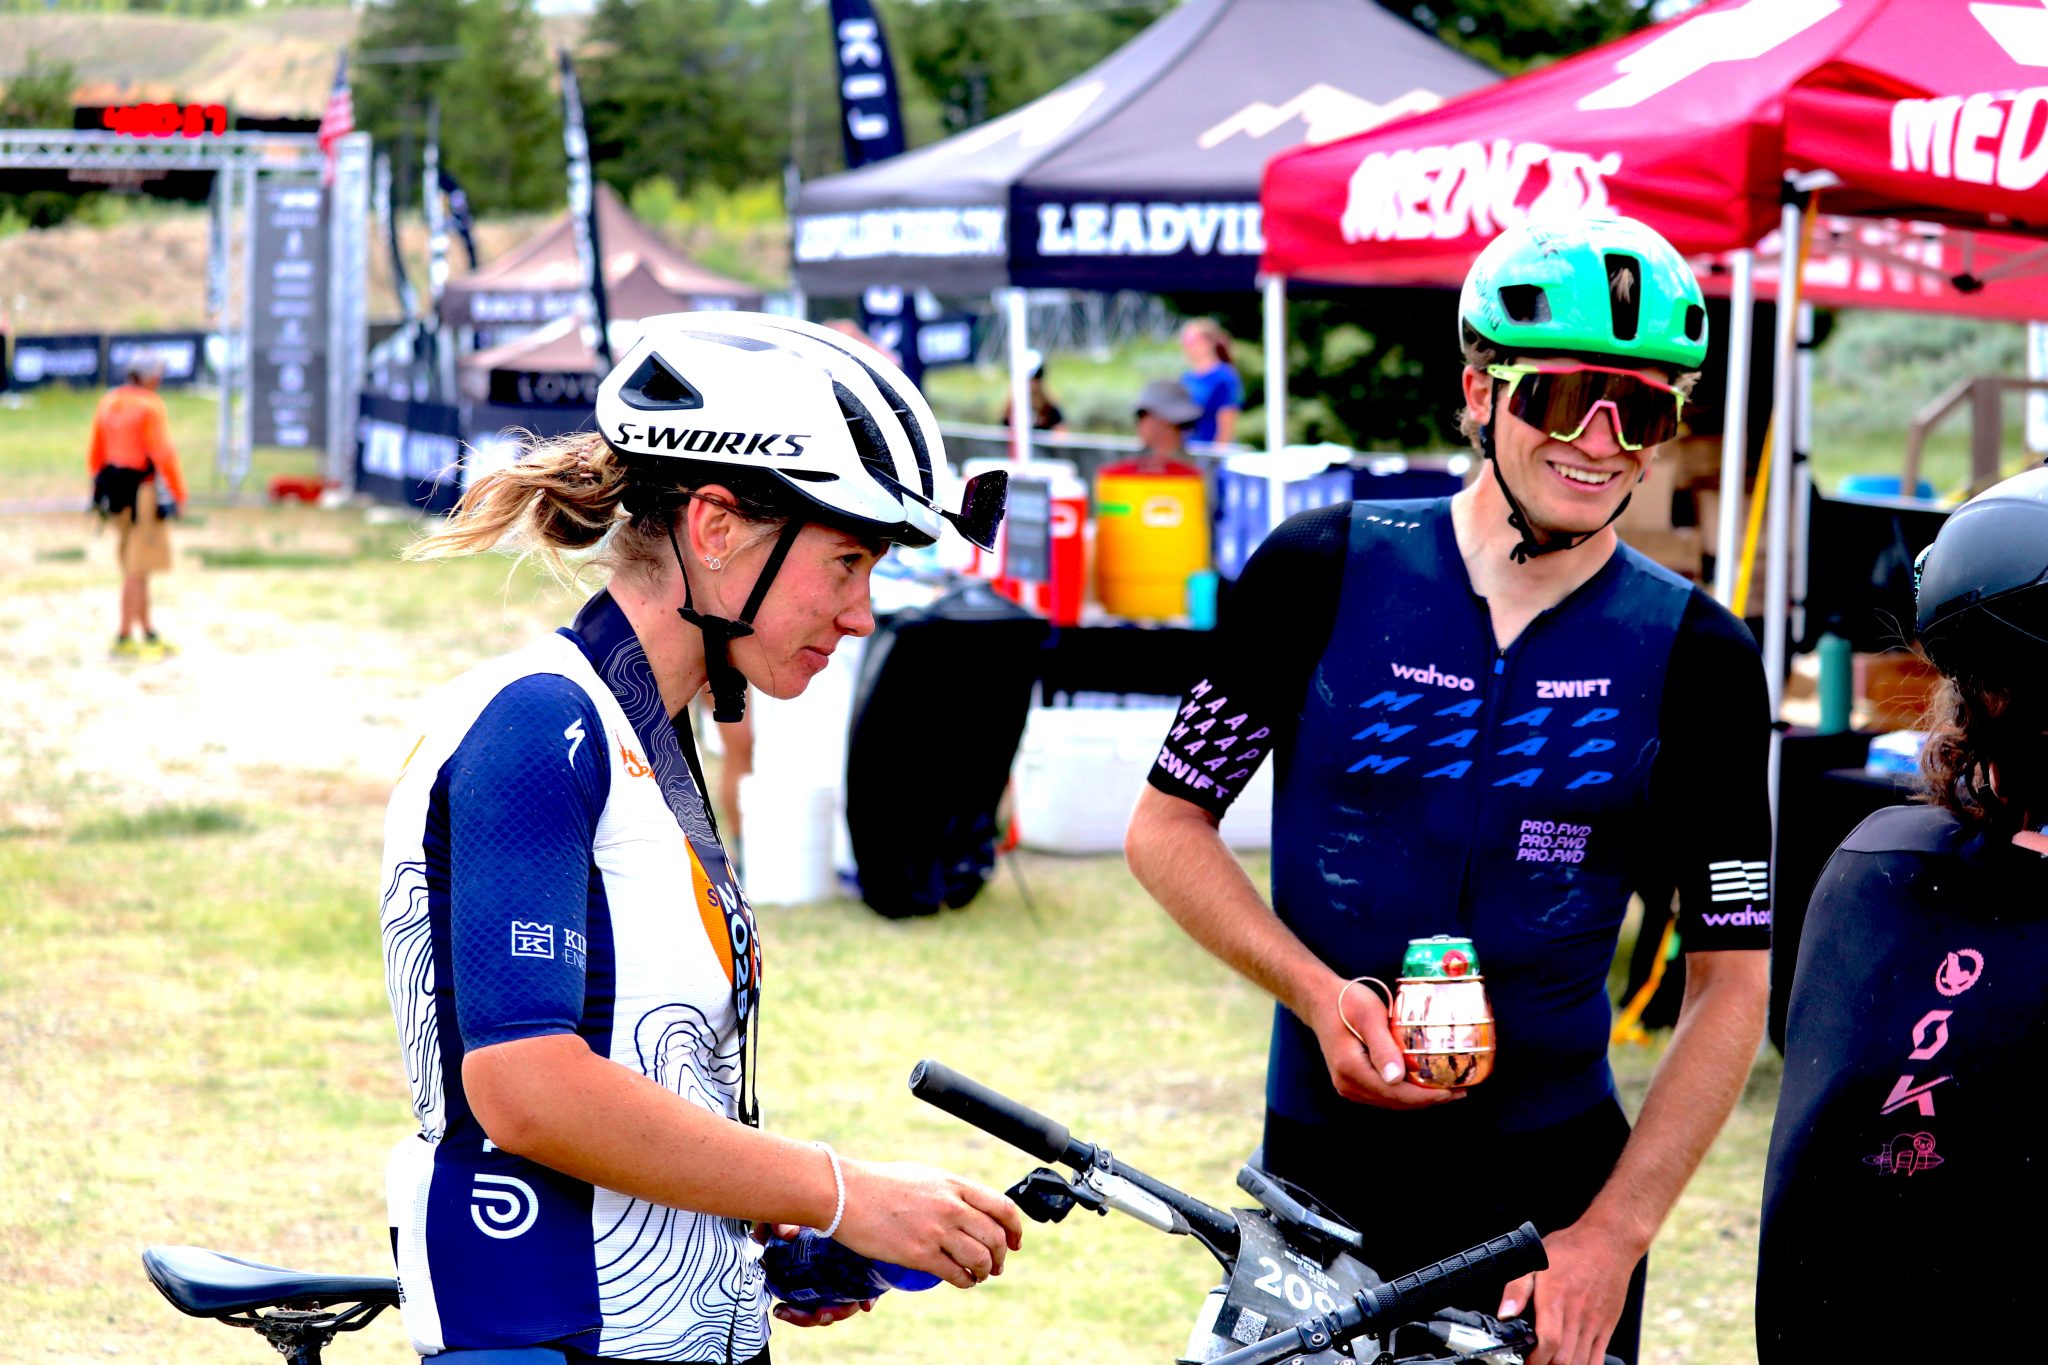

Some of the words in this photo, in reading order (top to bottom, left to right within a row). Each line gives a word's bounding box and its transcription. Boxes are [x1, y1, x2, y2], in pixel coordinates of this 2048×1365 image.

[1890, 86, 2048, 191] MED
[614, 423, 811, 457] S-WORKS
[1391, 663, 1475, 691] wahoo
[1536, 679, 1611, 698] ZWIFT
[1158, 745, 1229, 798] ZWIFT
[1520, 820, 1592, 836] PRO.FWD
[716, 881, 749, 1020] 2025
